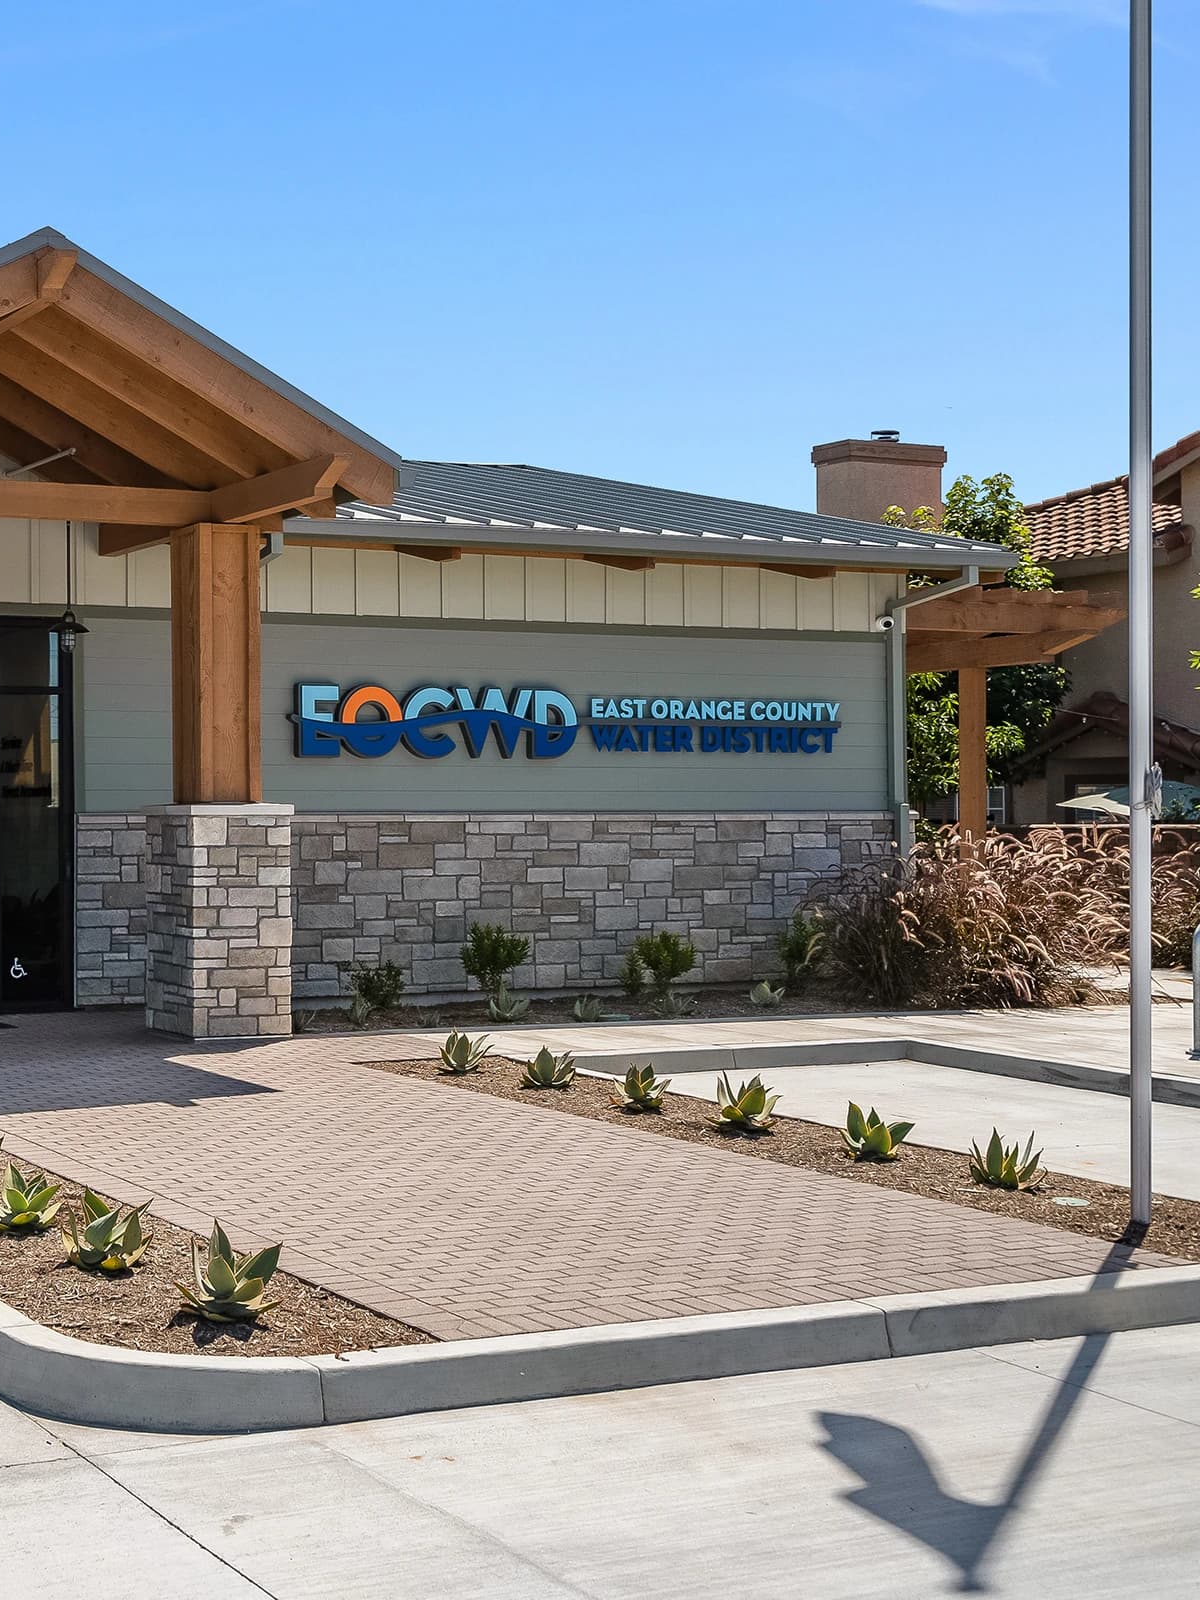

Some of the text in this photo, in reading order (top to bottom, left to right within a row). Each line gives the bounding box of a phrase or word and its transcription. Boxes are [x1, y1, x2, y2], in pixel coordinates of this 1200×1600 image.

[295, 683, 578, 758] EOCWD
[591, 698, 841, 721] EAST ORANGE COUNTY
[591, 725, 839, 753] WATER DISTRICT
